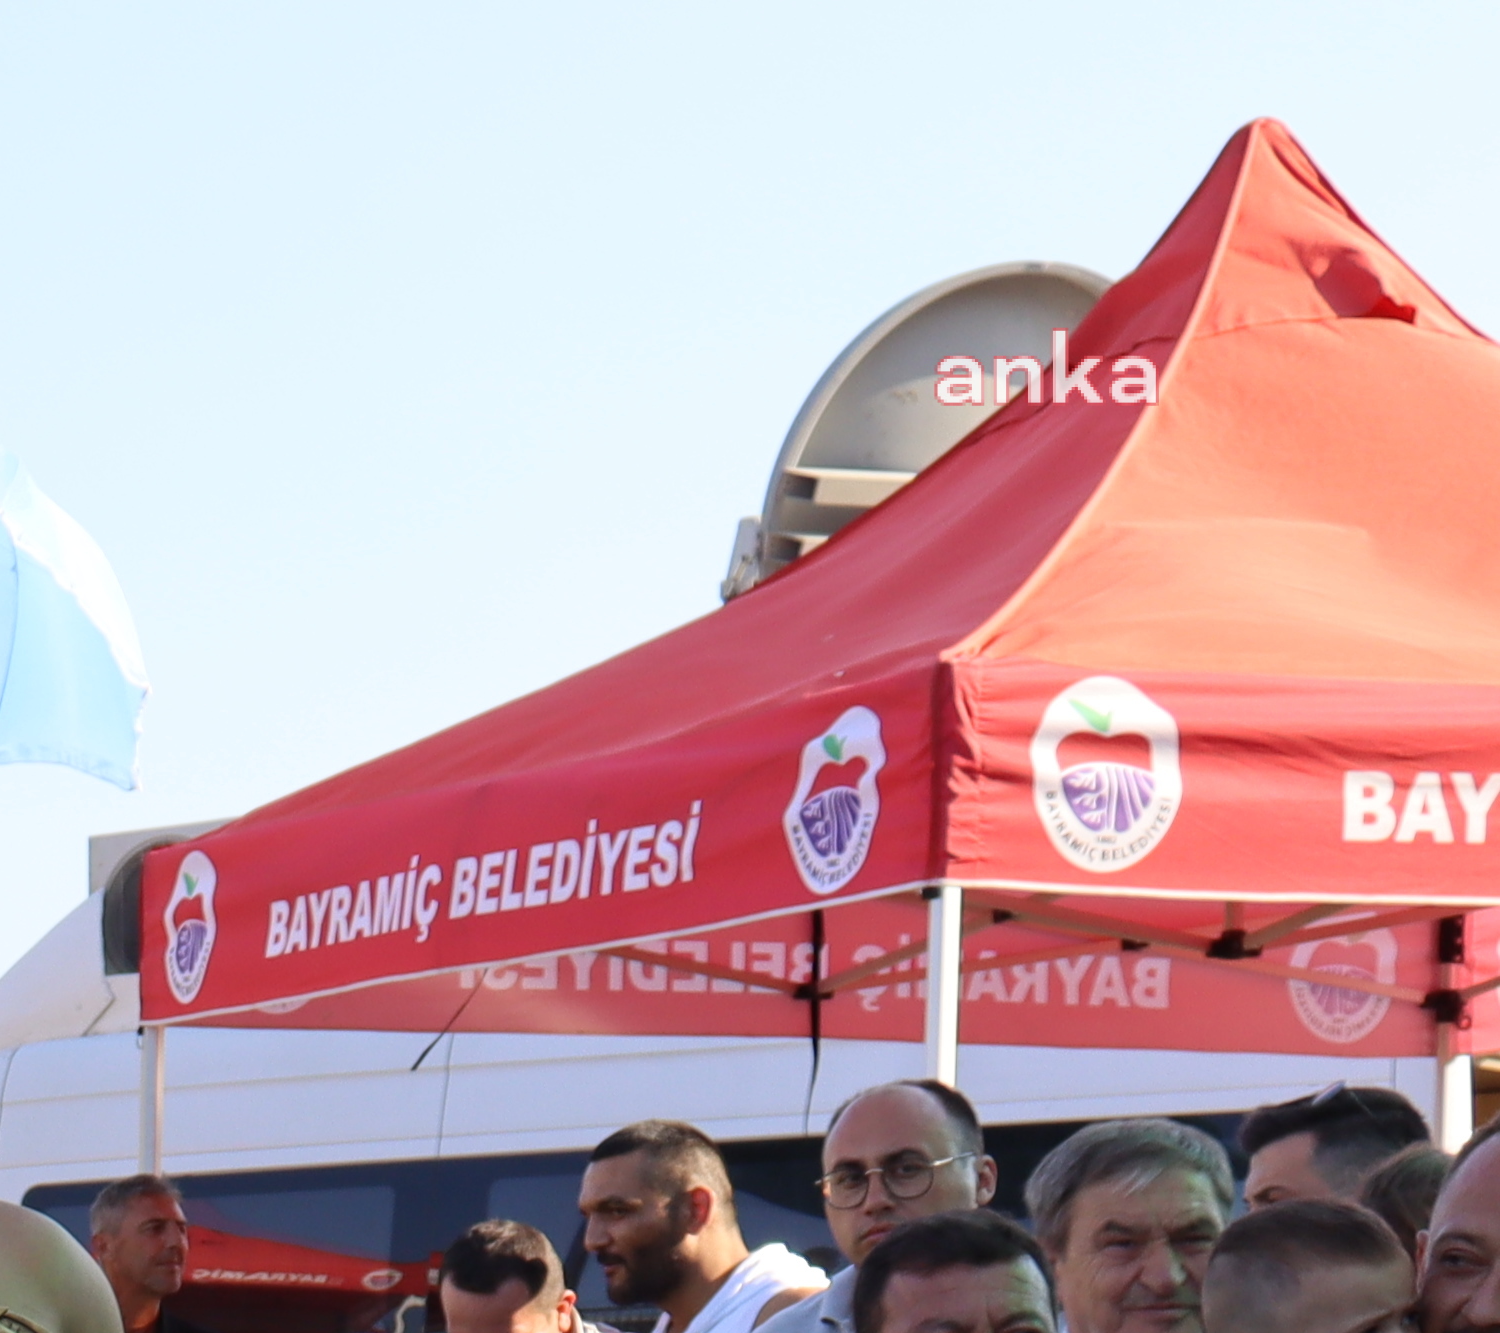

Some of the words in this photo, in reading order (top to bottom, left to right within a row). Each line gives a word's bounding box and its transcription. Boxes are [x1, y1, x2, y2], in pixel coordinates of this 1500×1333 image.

[1342, 770, 1500, 843] BAY
[265, 853, 442, 958] BAYRAMİÇ
[448, 799, 703, 920] BELEDİYESİ
